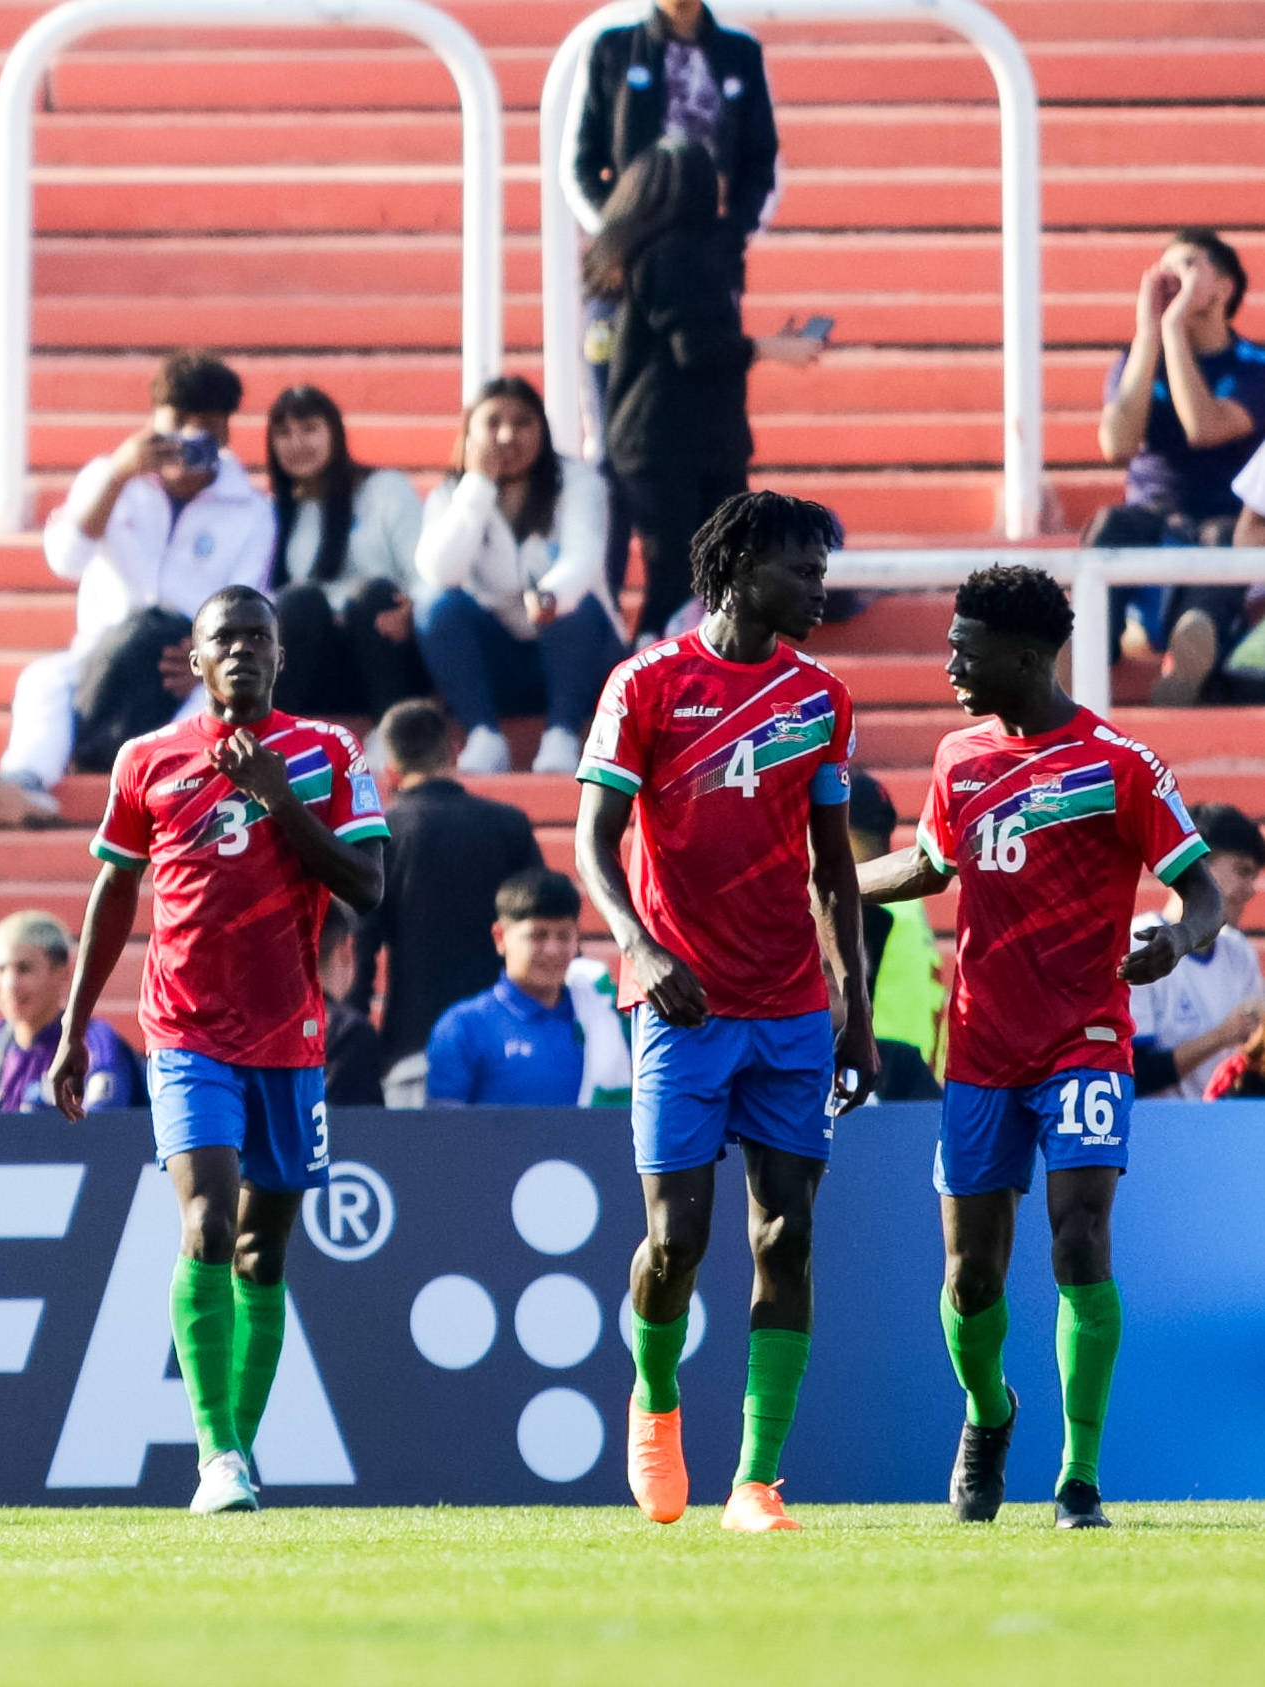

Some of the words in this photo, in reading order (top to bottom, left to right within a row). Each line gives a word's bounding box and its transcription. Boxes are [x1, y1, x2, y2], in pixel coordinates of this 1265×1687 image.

[672, 706, 723, 718] saller
[725, 740, 760, 798] 4
[217, 800, 249, 856] 3
[976, 813, 1027, 873] 16
[311, 1100, 328, 1158] 3
[1057, 1078, 1114, 1136] 16
[1080, 1134, 1122, 1146] saller
